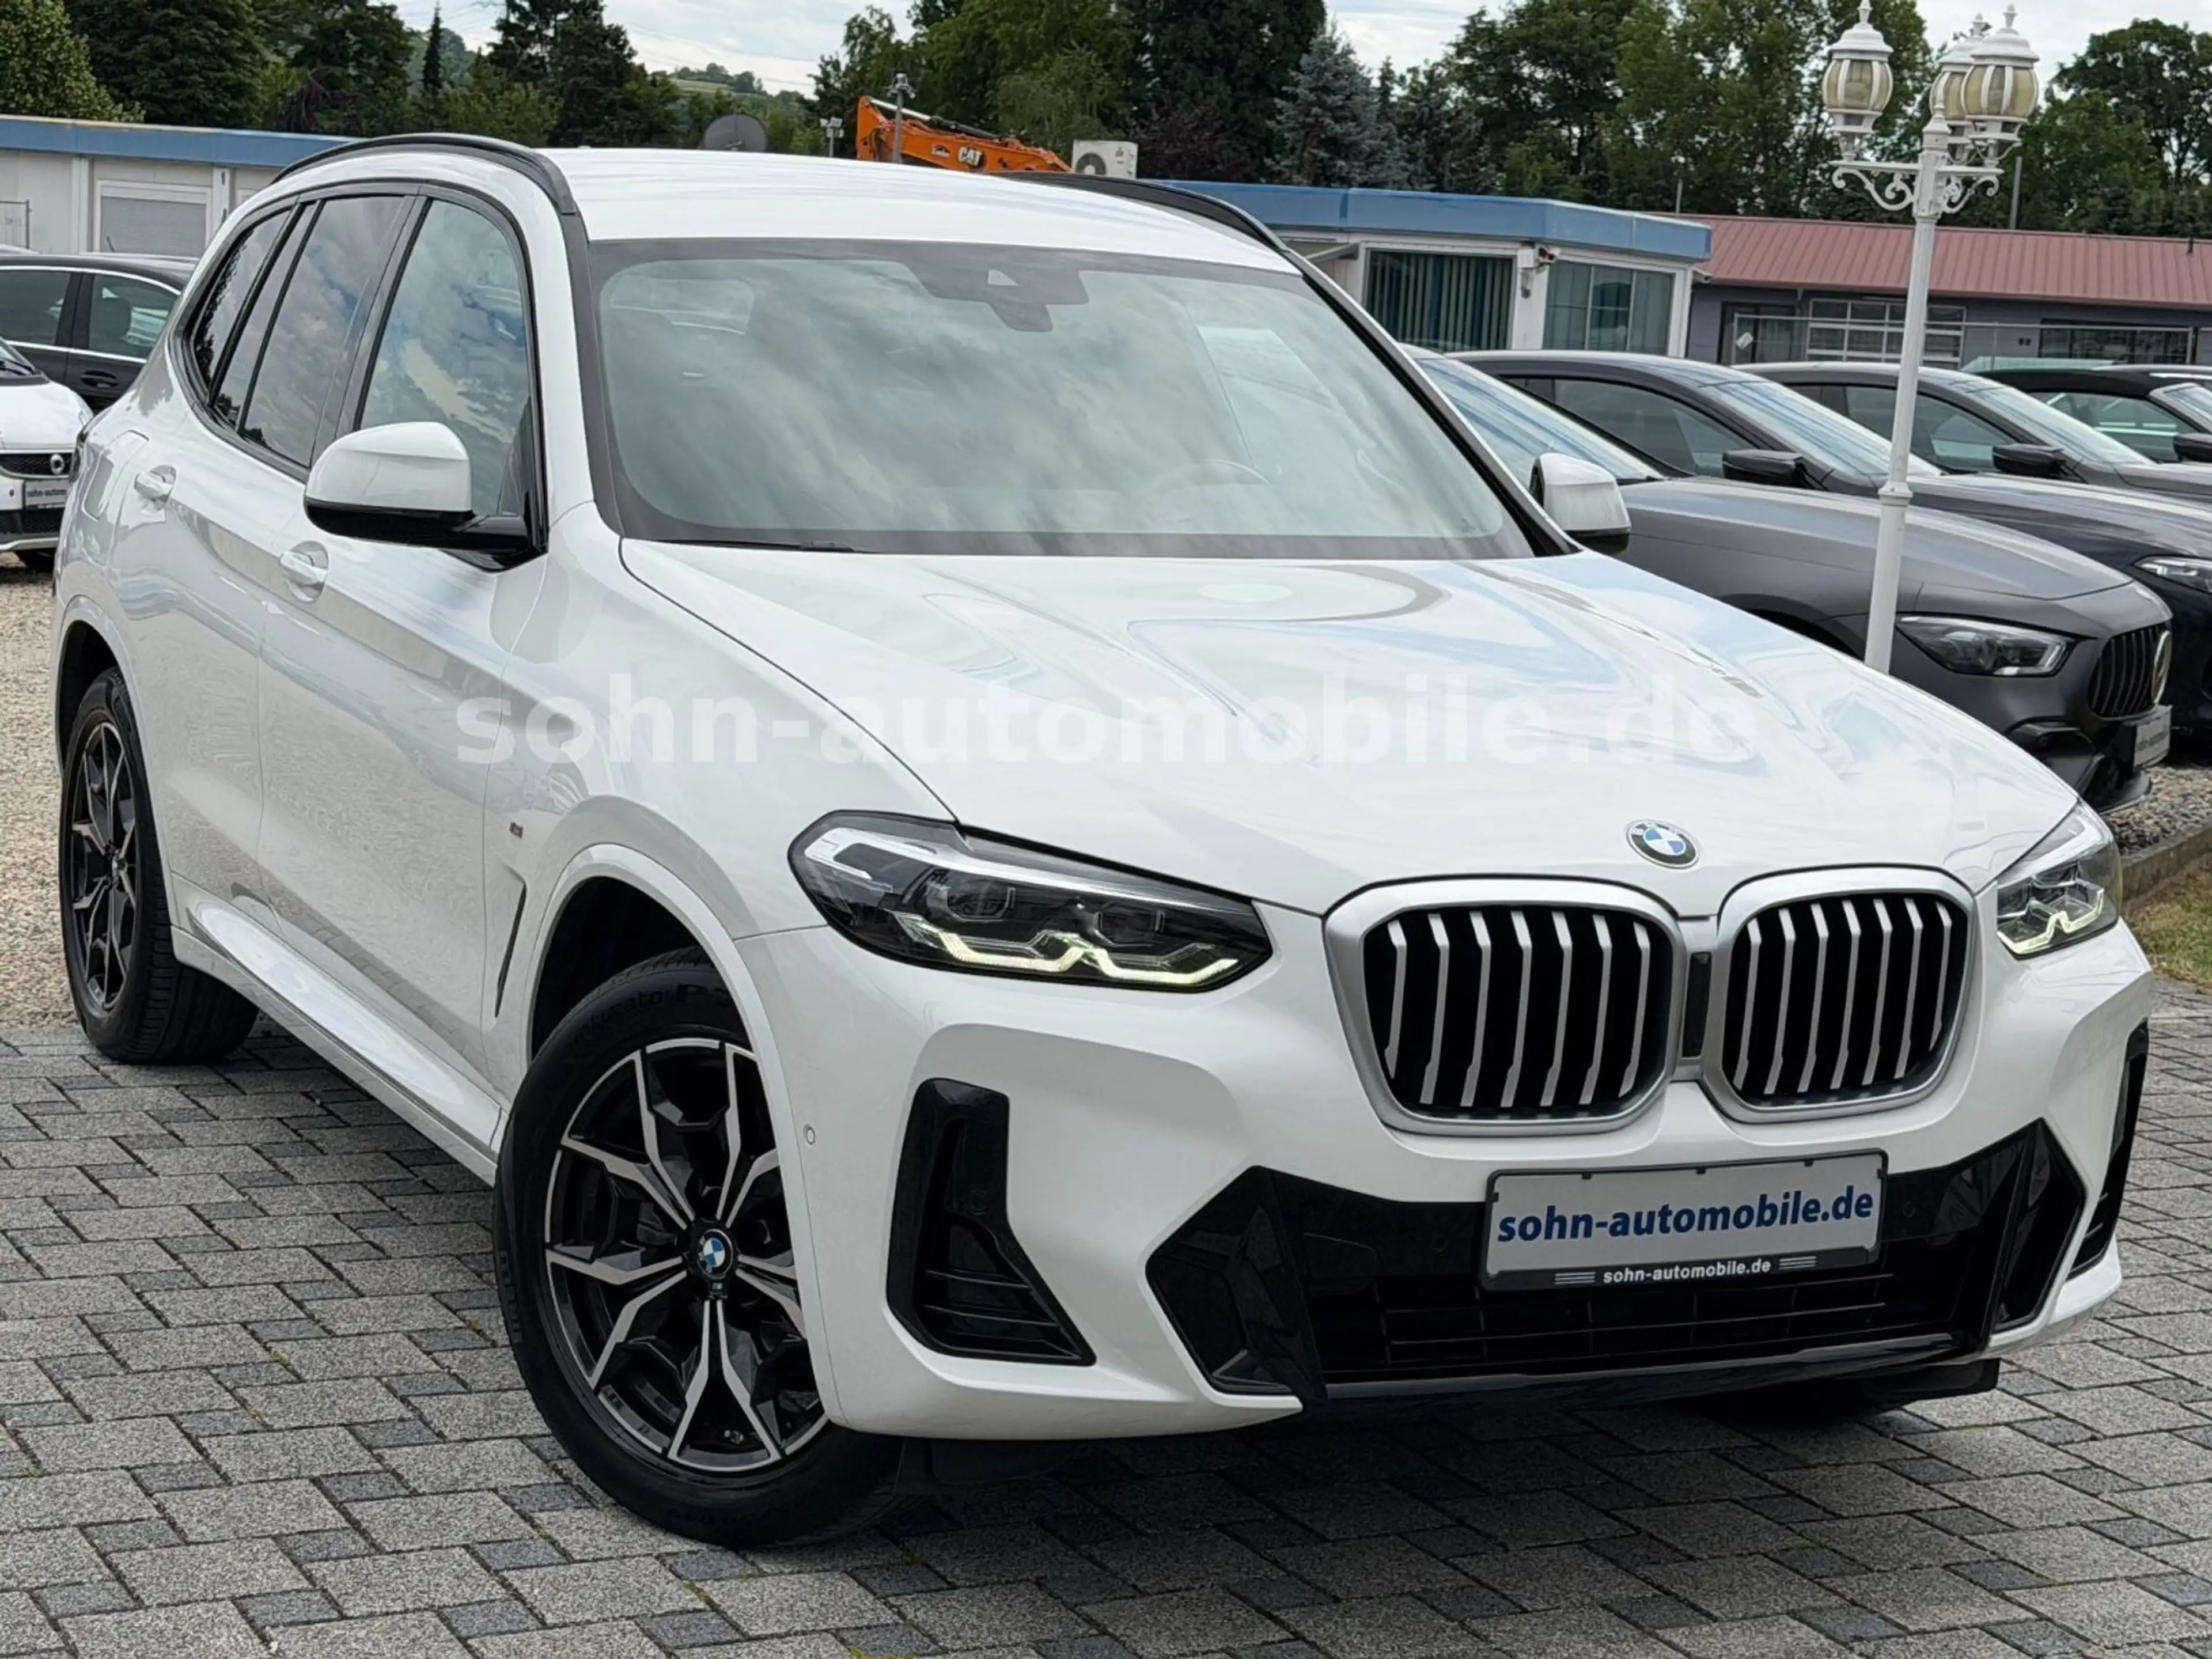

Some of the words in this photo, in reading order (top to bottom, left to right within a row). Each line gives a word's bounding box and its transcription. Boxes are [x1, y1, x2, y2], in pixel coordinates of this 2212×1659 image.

[957, 146, 982, 166] CAT
[1498, 1185, 1873, 1242] sohn-automobile.de
[1603, 1258, 1771, 1283] sohn-automobile.de
